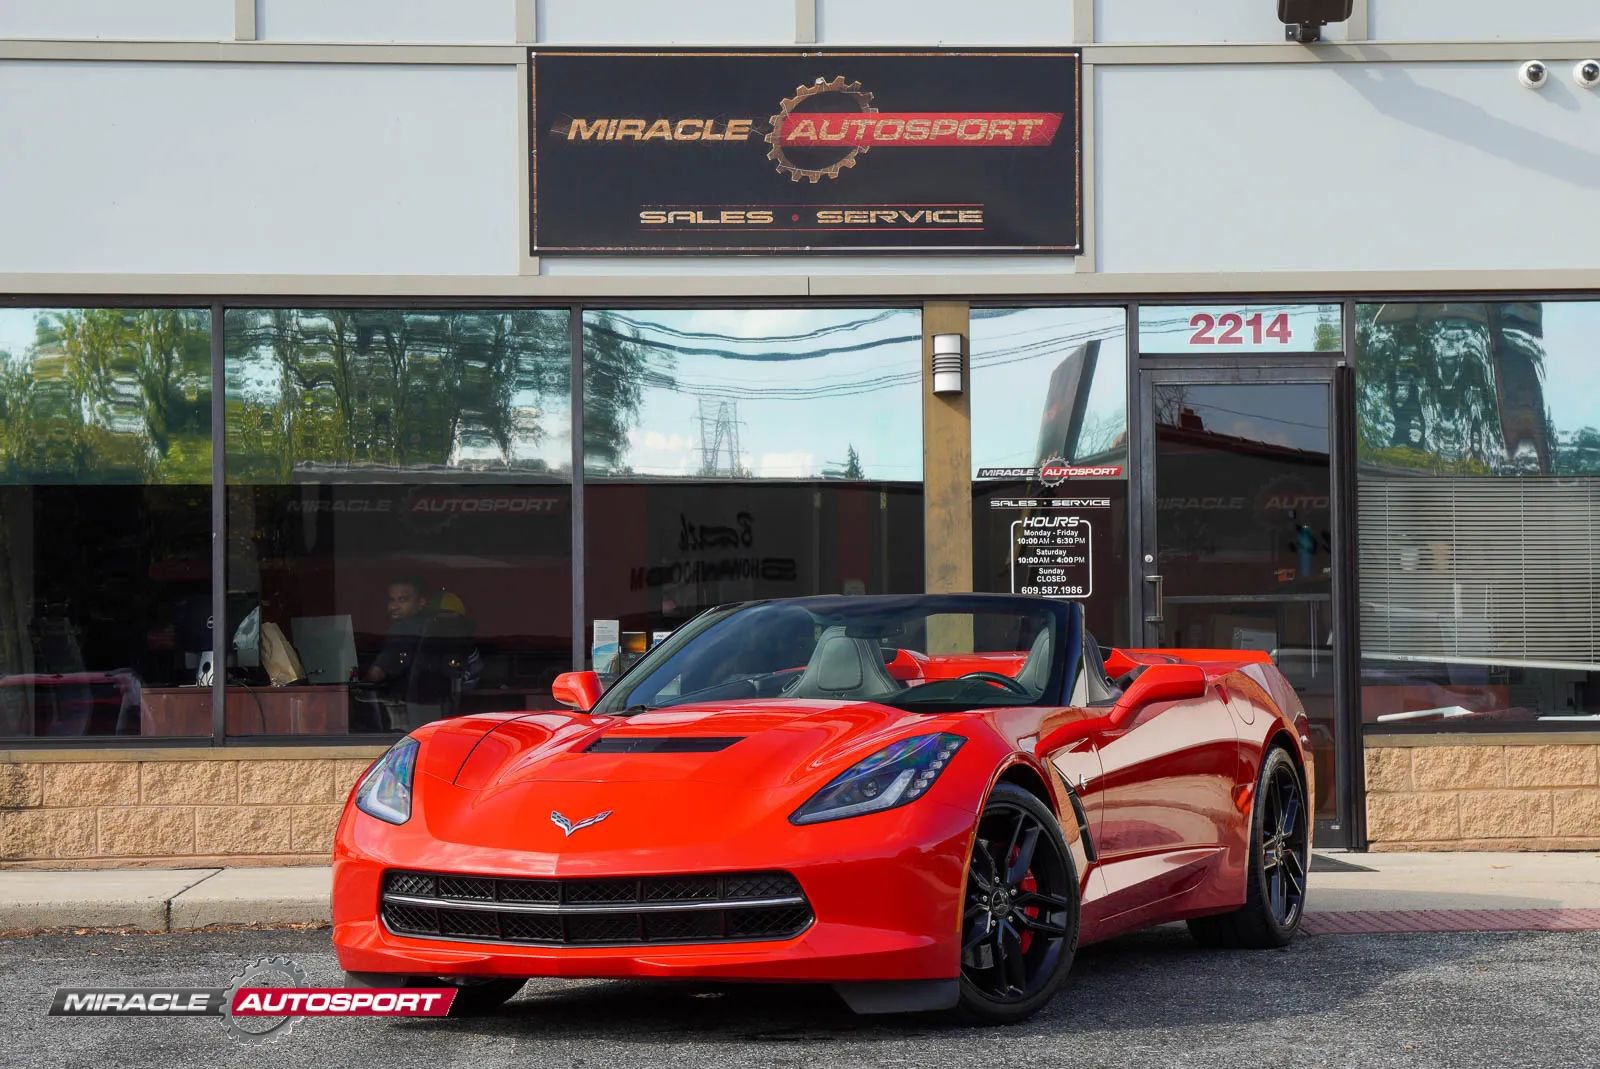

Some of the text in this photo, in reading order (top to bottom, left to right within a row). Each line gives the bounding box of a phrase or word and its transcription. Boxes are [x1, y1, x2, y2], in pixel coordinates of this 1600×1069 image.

[566, 118, 1044, 142] MIRACLE AUTOSPORT
[639, 209, 984, 224] SALES SERVICE
[1189, 312, 1293, 345] 2214
[981, 467, 1118, 477] MIRACLE AUTOSPORT
[287, 499, 559, 513] MIRACLE AUTOSPORT
[1023, 516, 1080, 527] HOURS
[1036, 575, 1067, 583] CLOSED
[1021, 586, 1083, 594] 609.587.1986
